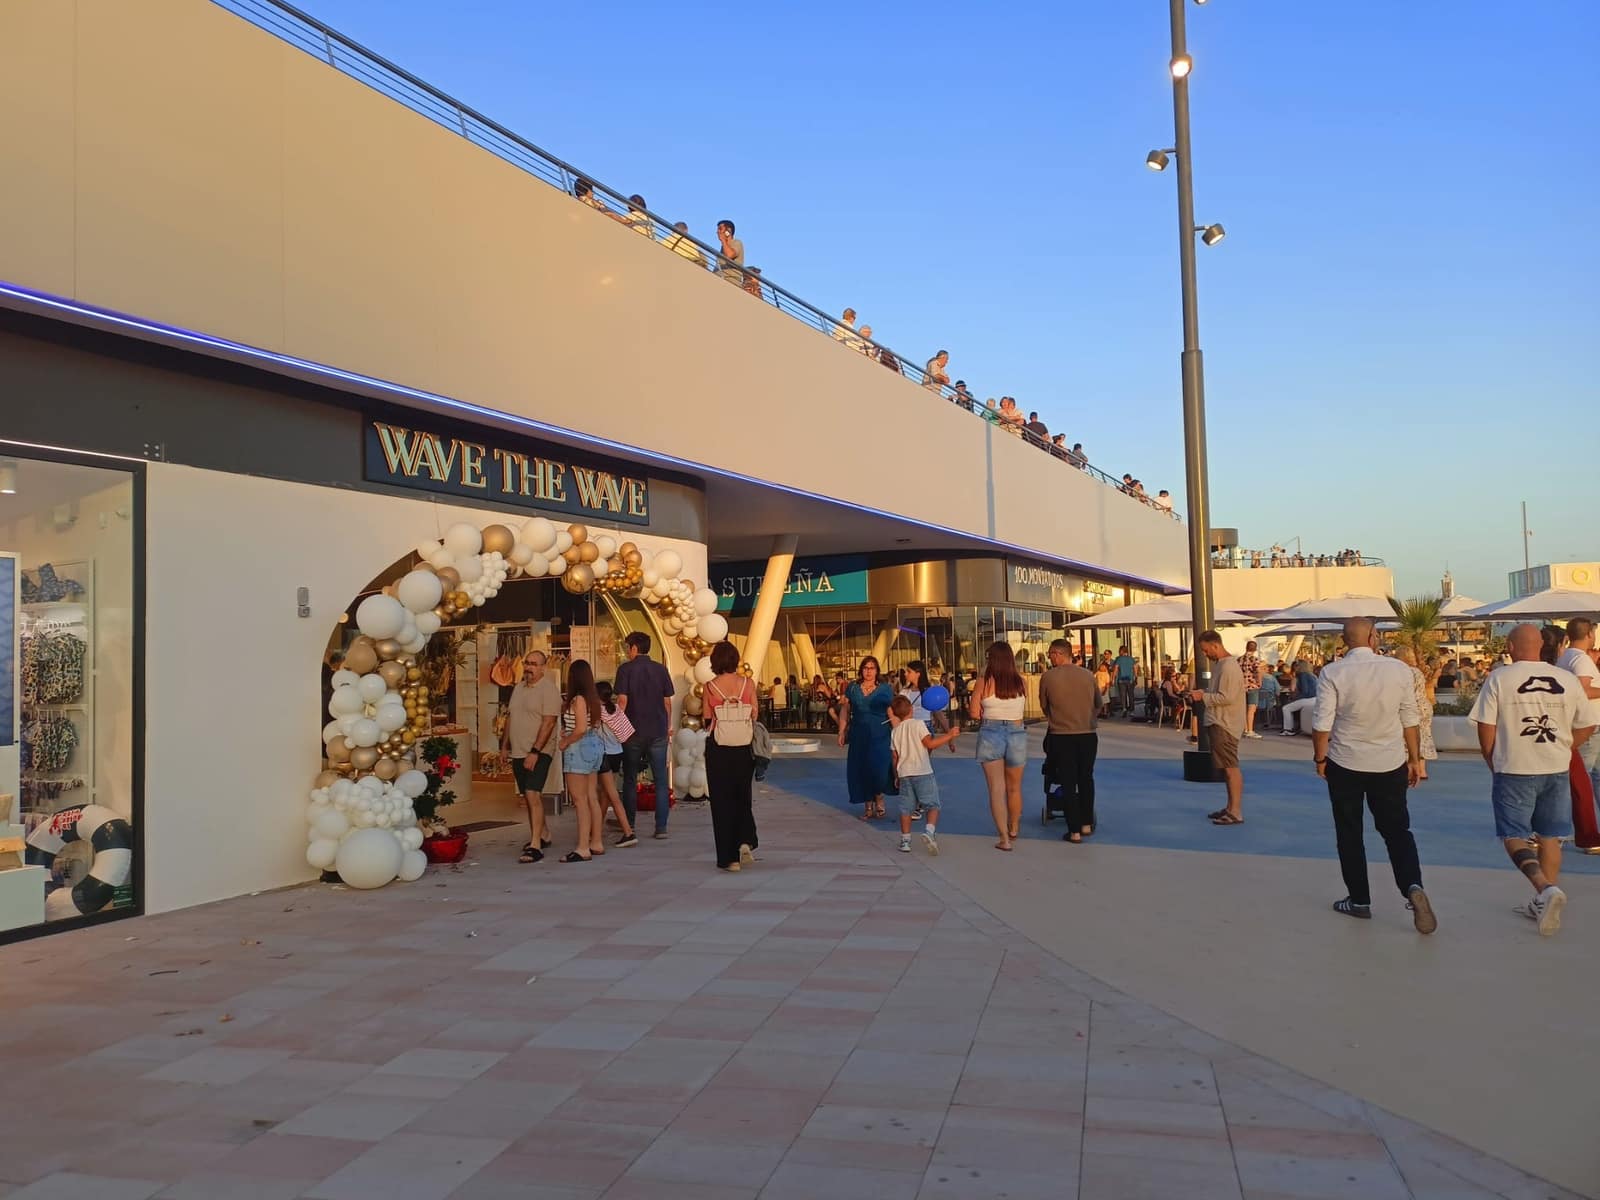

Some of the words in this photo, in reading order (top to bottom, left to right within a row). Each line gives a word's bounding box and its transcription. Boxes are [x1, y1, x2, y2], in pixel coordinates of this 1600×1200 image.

[373, 421, 487, 488] WAVE
[494, 448, 566, 502] THE
[571, 465, 647, 517] WAVE
[722, 567, 835, 597] SUÑA
[1015, 565, 1027, 584] 100
